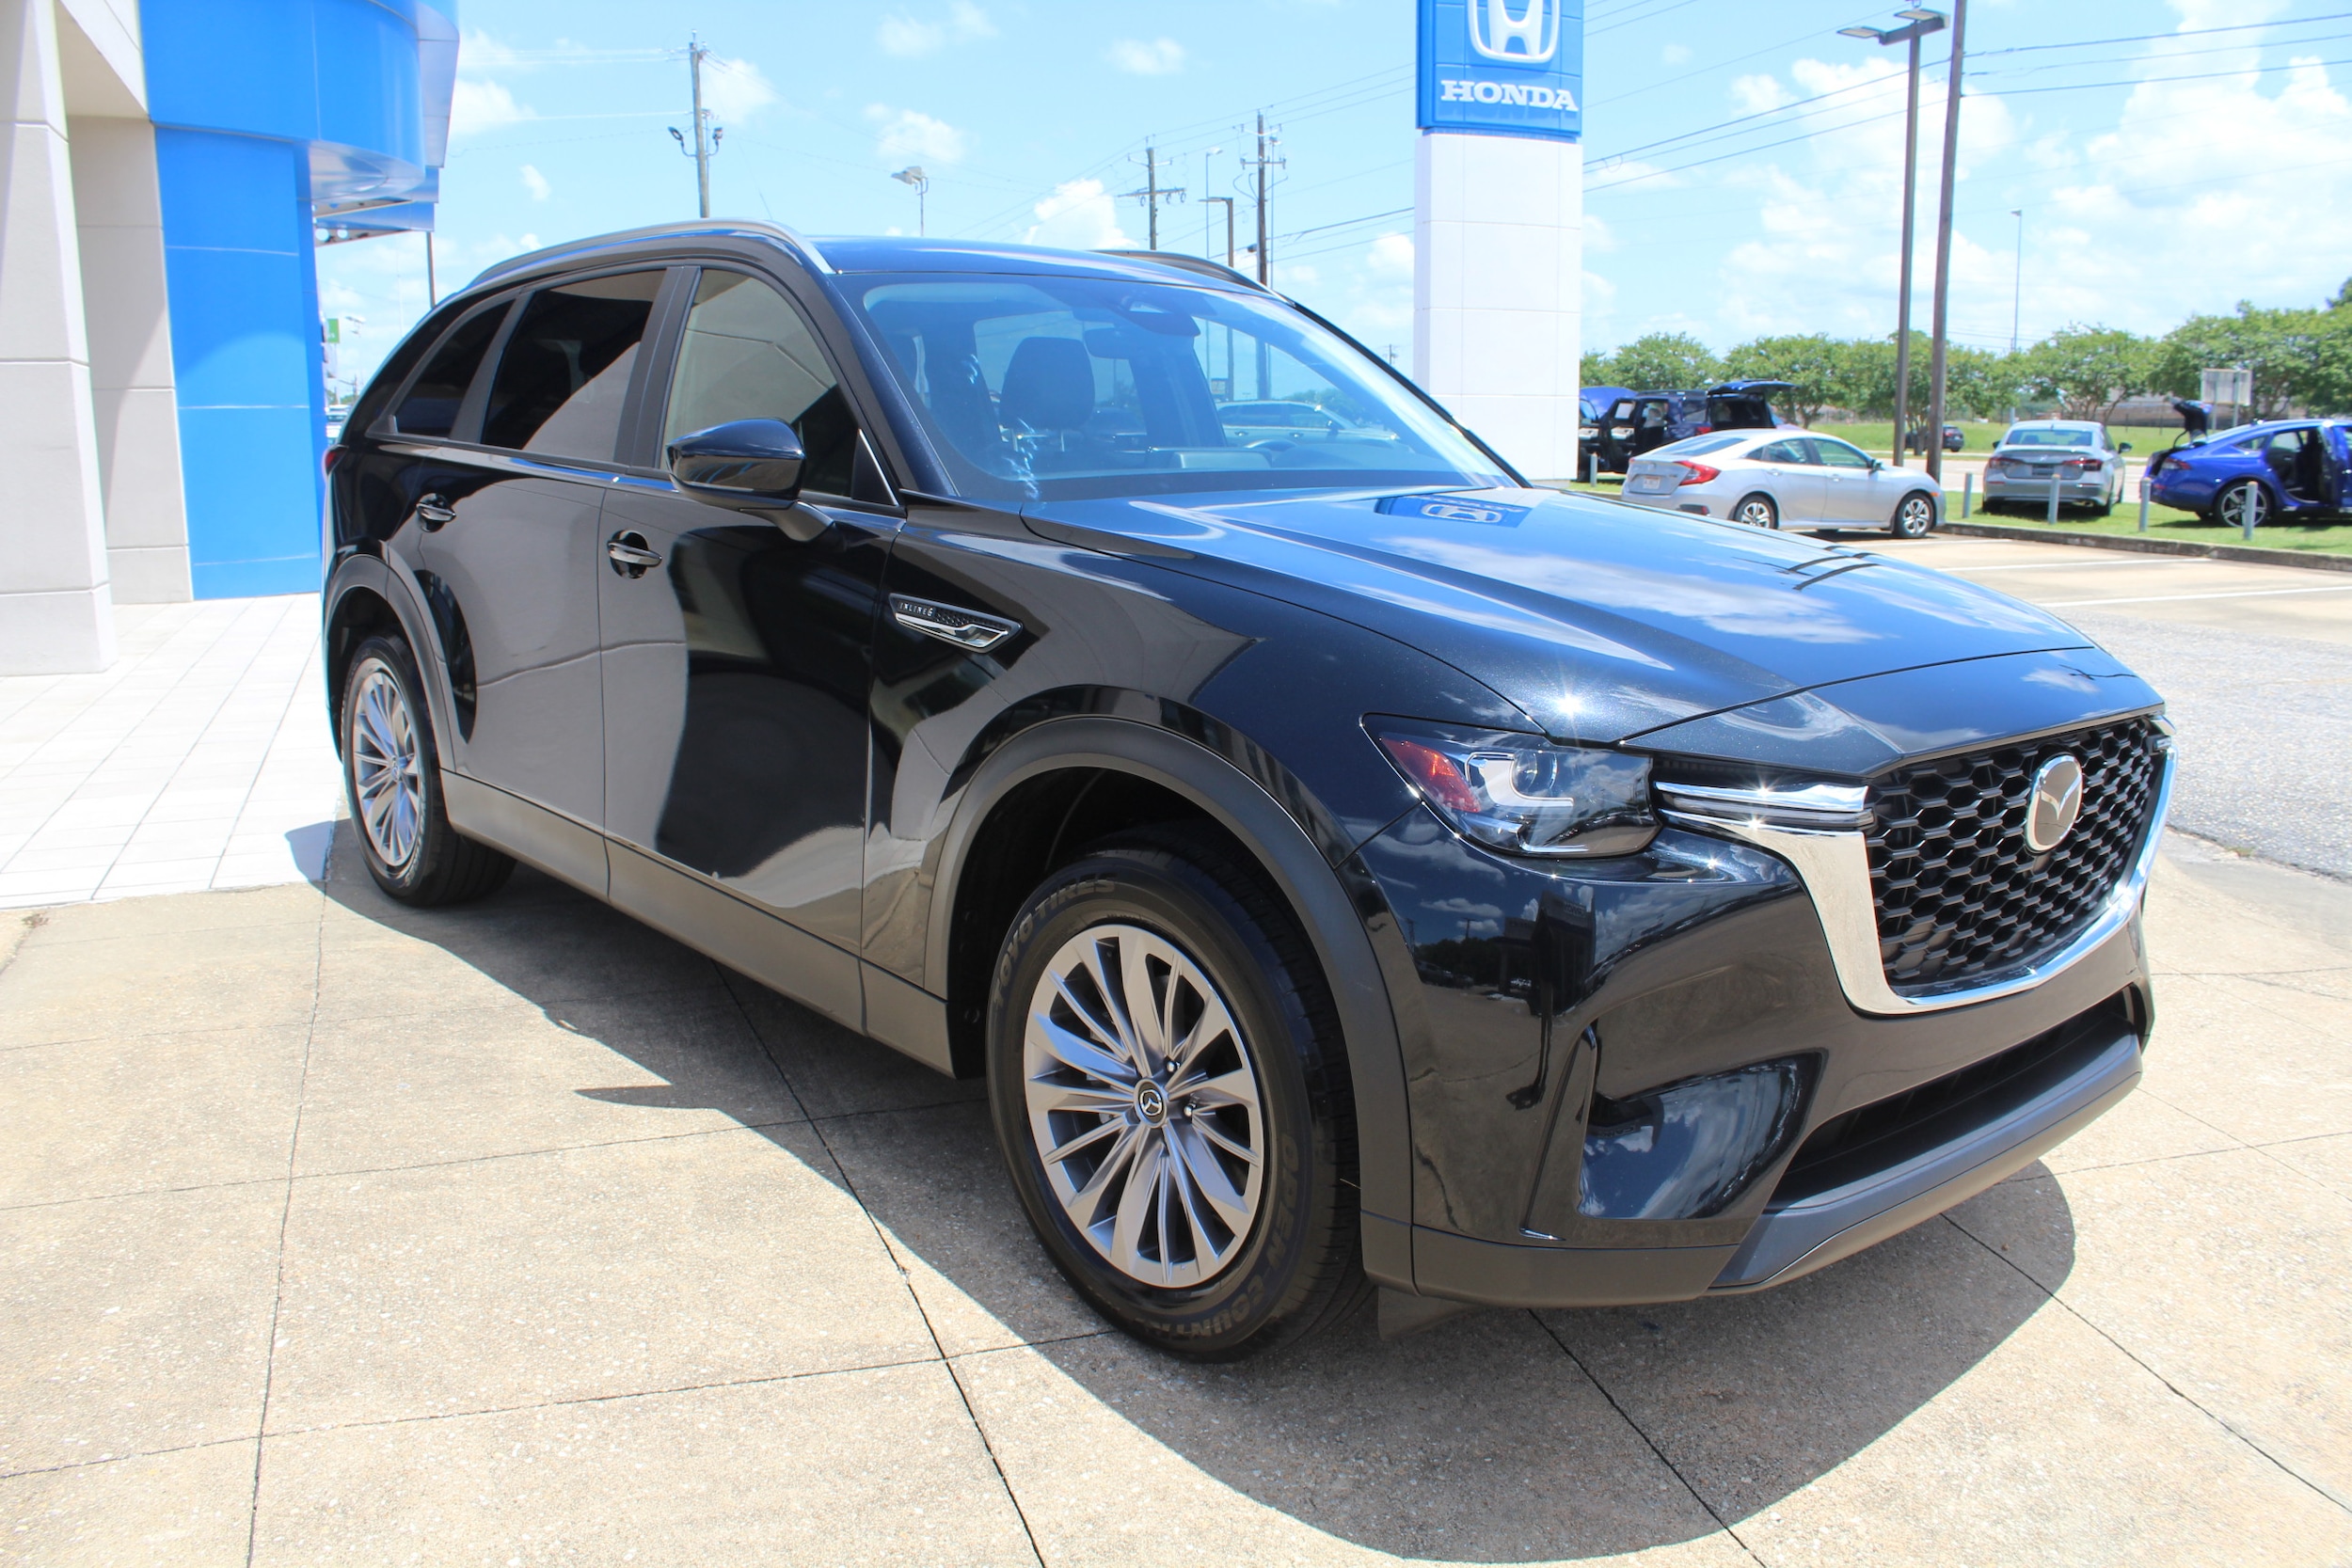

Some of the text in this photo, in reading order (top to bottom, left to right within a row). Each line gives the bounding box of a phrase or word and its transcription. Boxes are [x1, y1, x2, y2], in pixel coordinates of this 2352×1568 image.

[1440, 80, 1579, 112] HONDA
[992, 873, 1116, 1009] TOYO TIRES
[1266, 1132, 1299, 1268] OPEN
